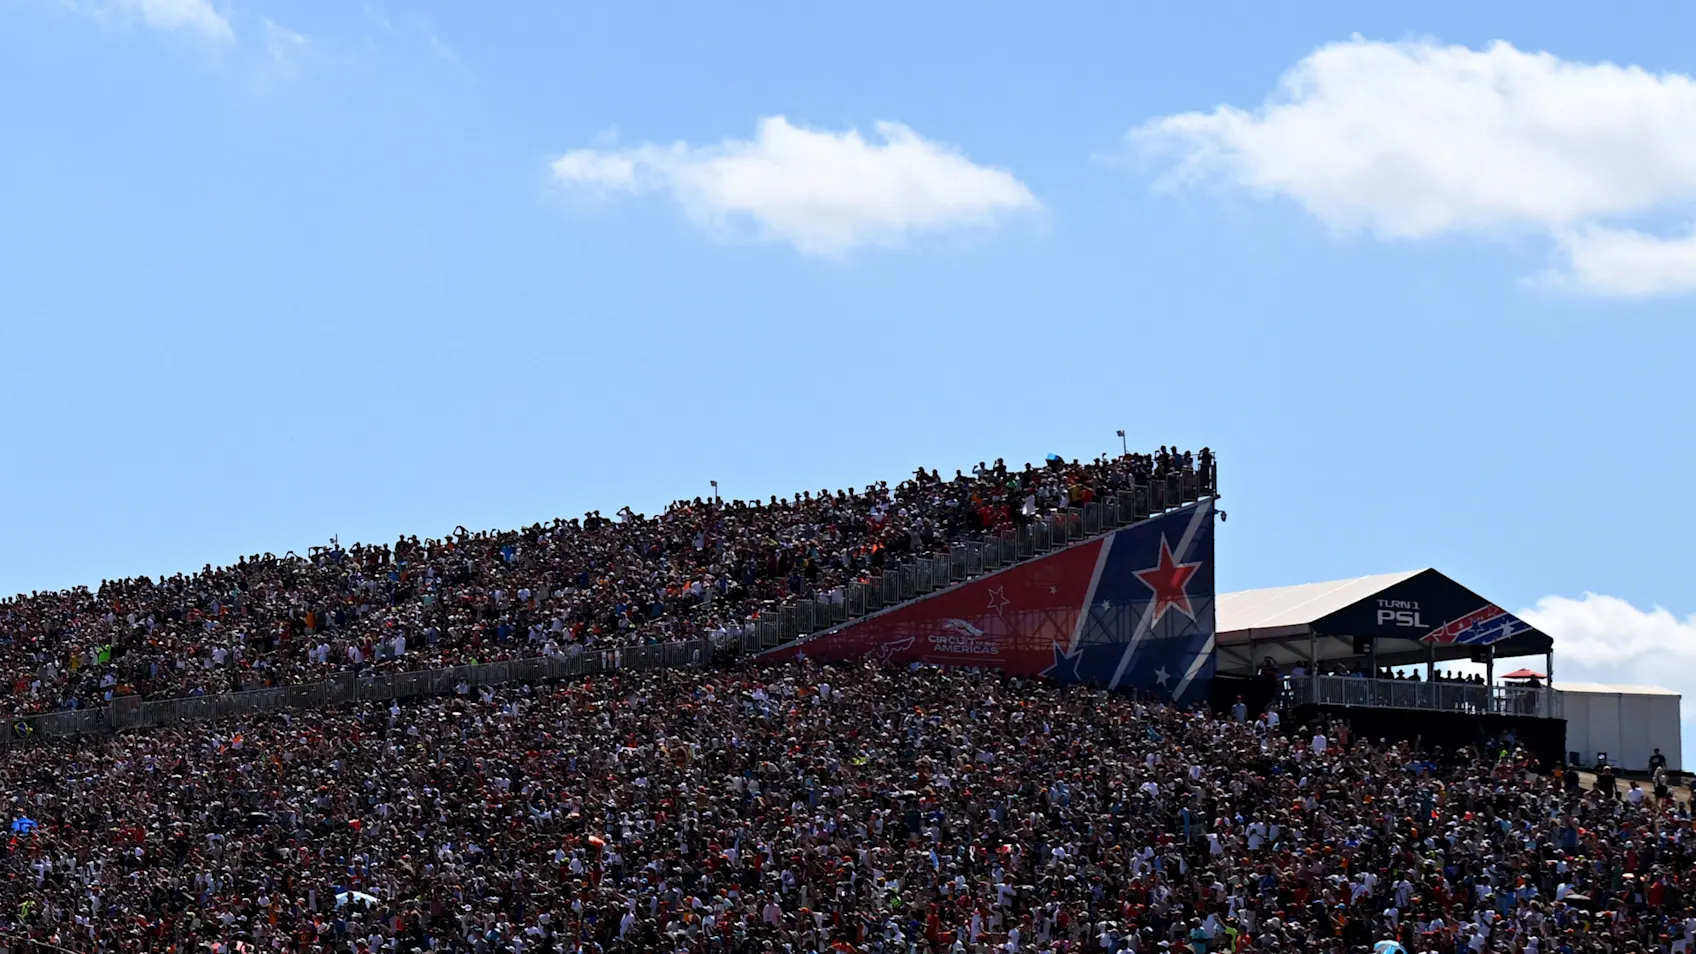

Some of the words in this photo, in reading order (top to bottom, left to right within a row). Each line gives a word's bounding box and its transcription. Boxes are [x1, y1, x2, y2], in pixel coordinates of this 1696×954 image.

[1376, 599, 1411, 609] TURN
[1412, 600, 1421, 610] 1
[1377, 609, 1430, 628] PSL
[927, 634, 976, 645] CIRCUIT
[933, 643, 1000, 655] AMERICAS
